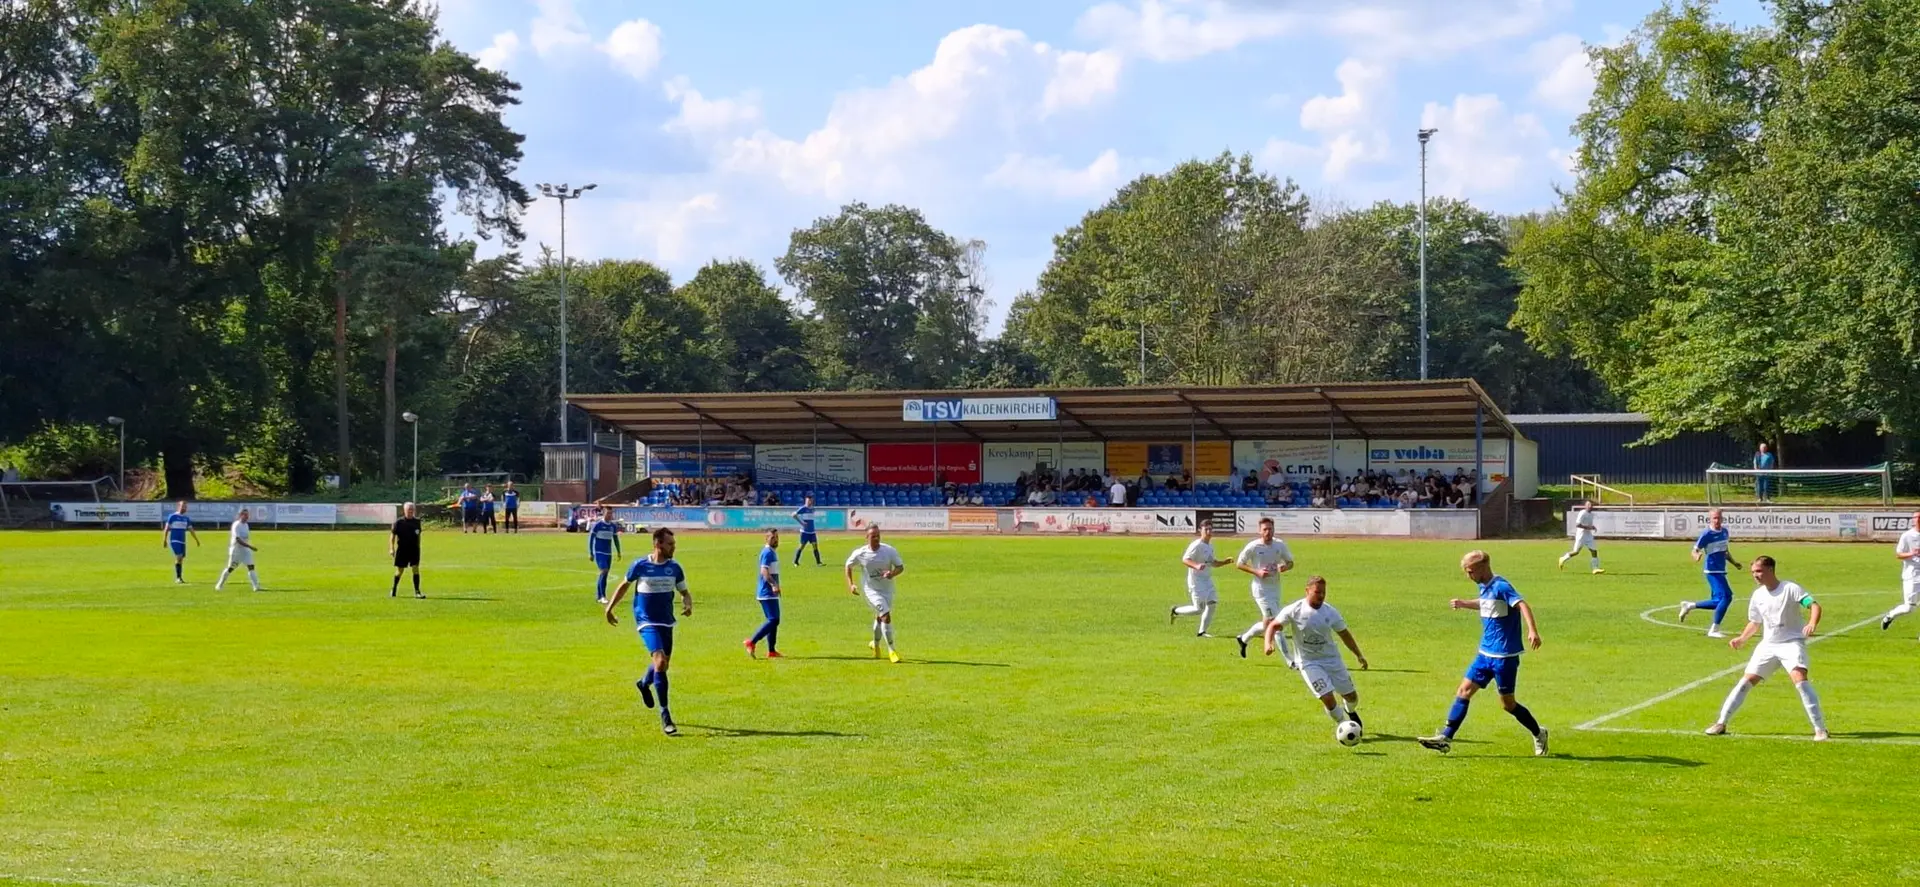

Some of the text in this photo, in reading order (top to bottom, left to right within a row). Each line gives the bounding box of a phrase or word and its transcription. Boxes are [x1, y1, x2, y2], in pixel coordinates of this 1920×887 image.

[924, 401, 1049, 418] TSV KALDENKIRCHEN
[988, 449, 1034, 459] Kreykamp
[1394, 445, 1444, 459] voba
[1697, 515, 1753, 524] Reebüro
[1759, 514, 1801, 524] Wilfried
[1806, 514, 1831, 524] Ulen
